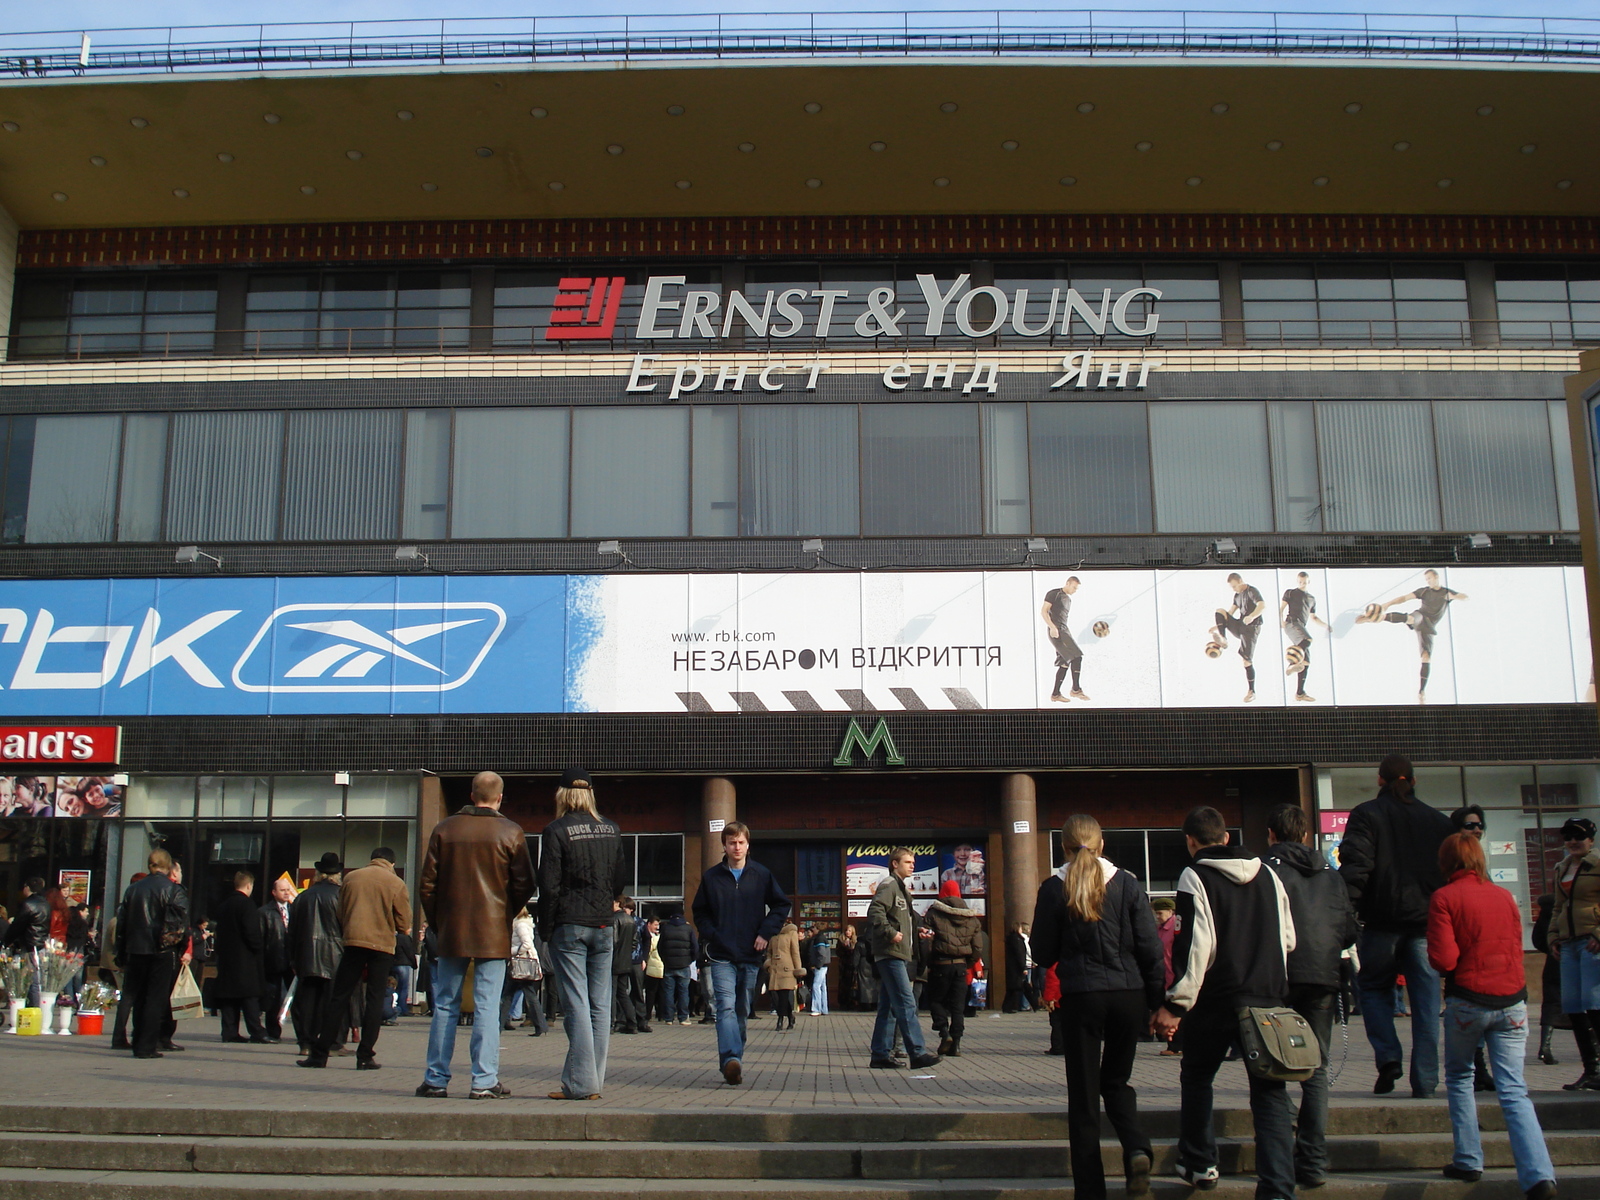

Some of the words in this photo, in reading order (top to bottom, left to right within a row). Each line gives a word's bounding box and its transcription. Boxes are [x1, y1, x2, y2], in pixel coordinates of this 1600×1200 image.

[635, 274, 849, 340] ERNST
[854, 287, 906, 338] &
[915, 272, 1164, 338] YOUNG
[624, 353, 830, 400] Ернст
[883, 362, 999, 394] енд
[1051, 349, 1165, 390] Янг
[673, 648, 839, 672] НЕЗАБАРОМ
[852, 645, 1002, 671] ВІДКРИТТЯ
[0, 731, 94, 760] ald's
[566, 823, 592, 836] BUCK
